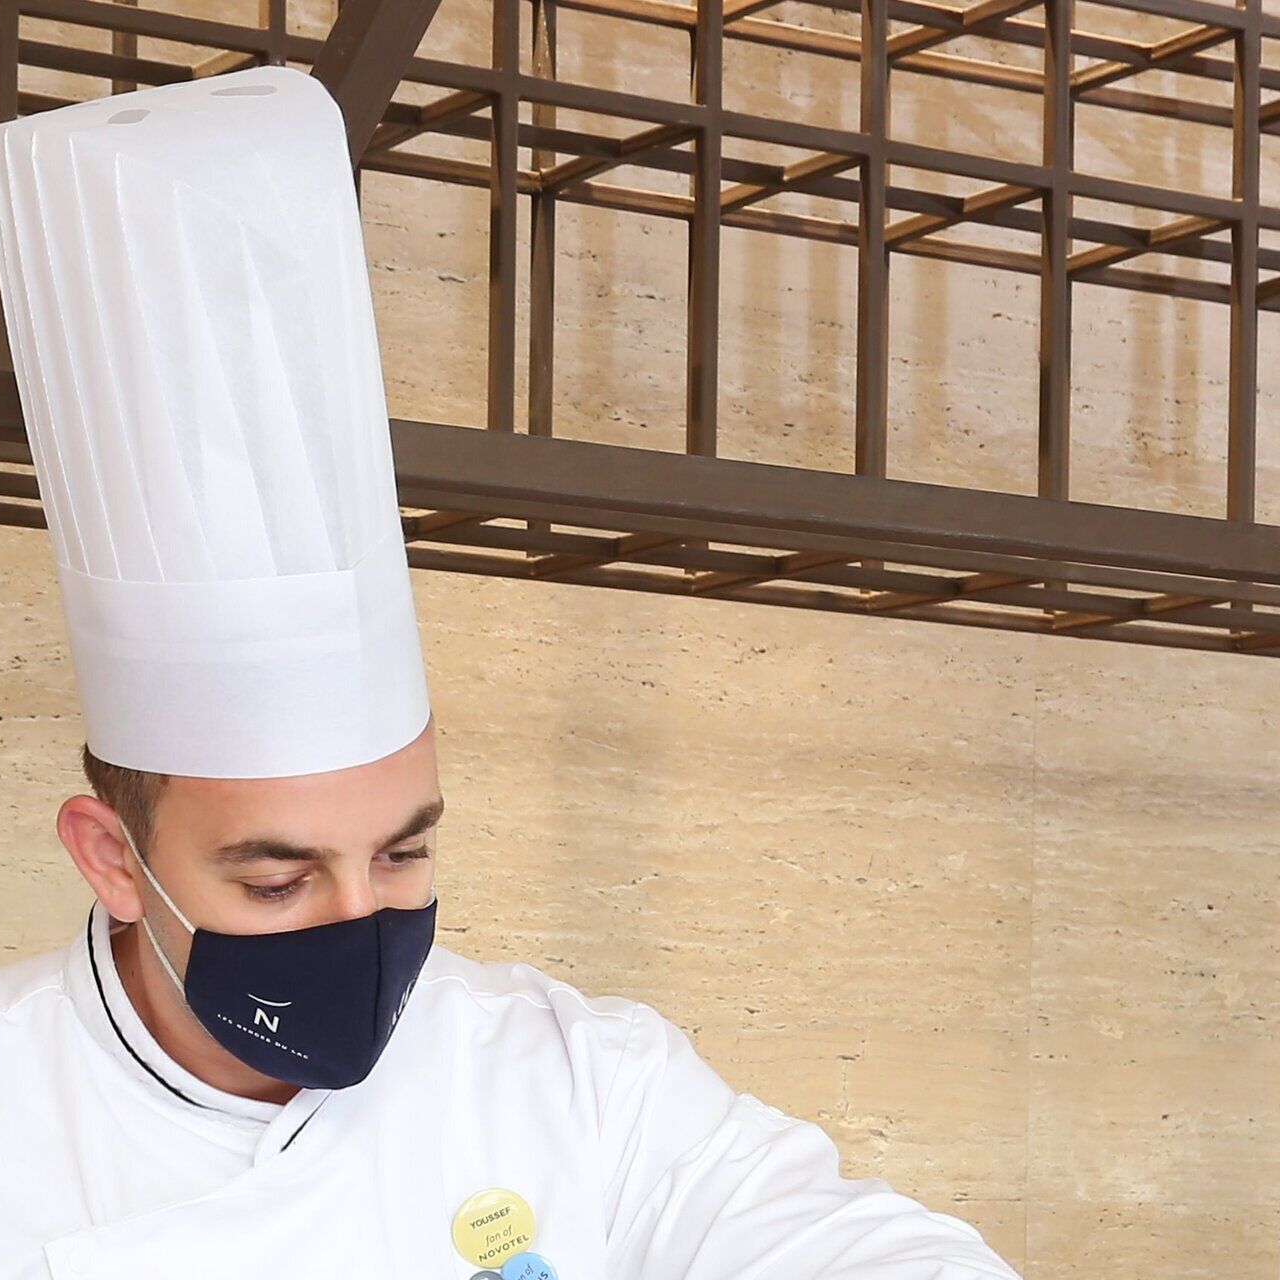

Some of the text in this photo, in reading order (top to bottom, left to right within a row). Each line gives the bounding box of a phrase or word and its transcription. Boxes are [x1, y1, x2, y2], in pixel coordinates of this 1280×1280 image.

[253, 1007, 280, 1033] N
[470, 1206, 510, 1229] YOUSSEF
[485, 1224, 513, 1247] fan of
[478, 1234, 529, 1262] NOVOTEL
[525, 1263, 534, 1275] of
